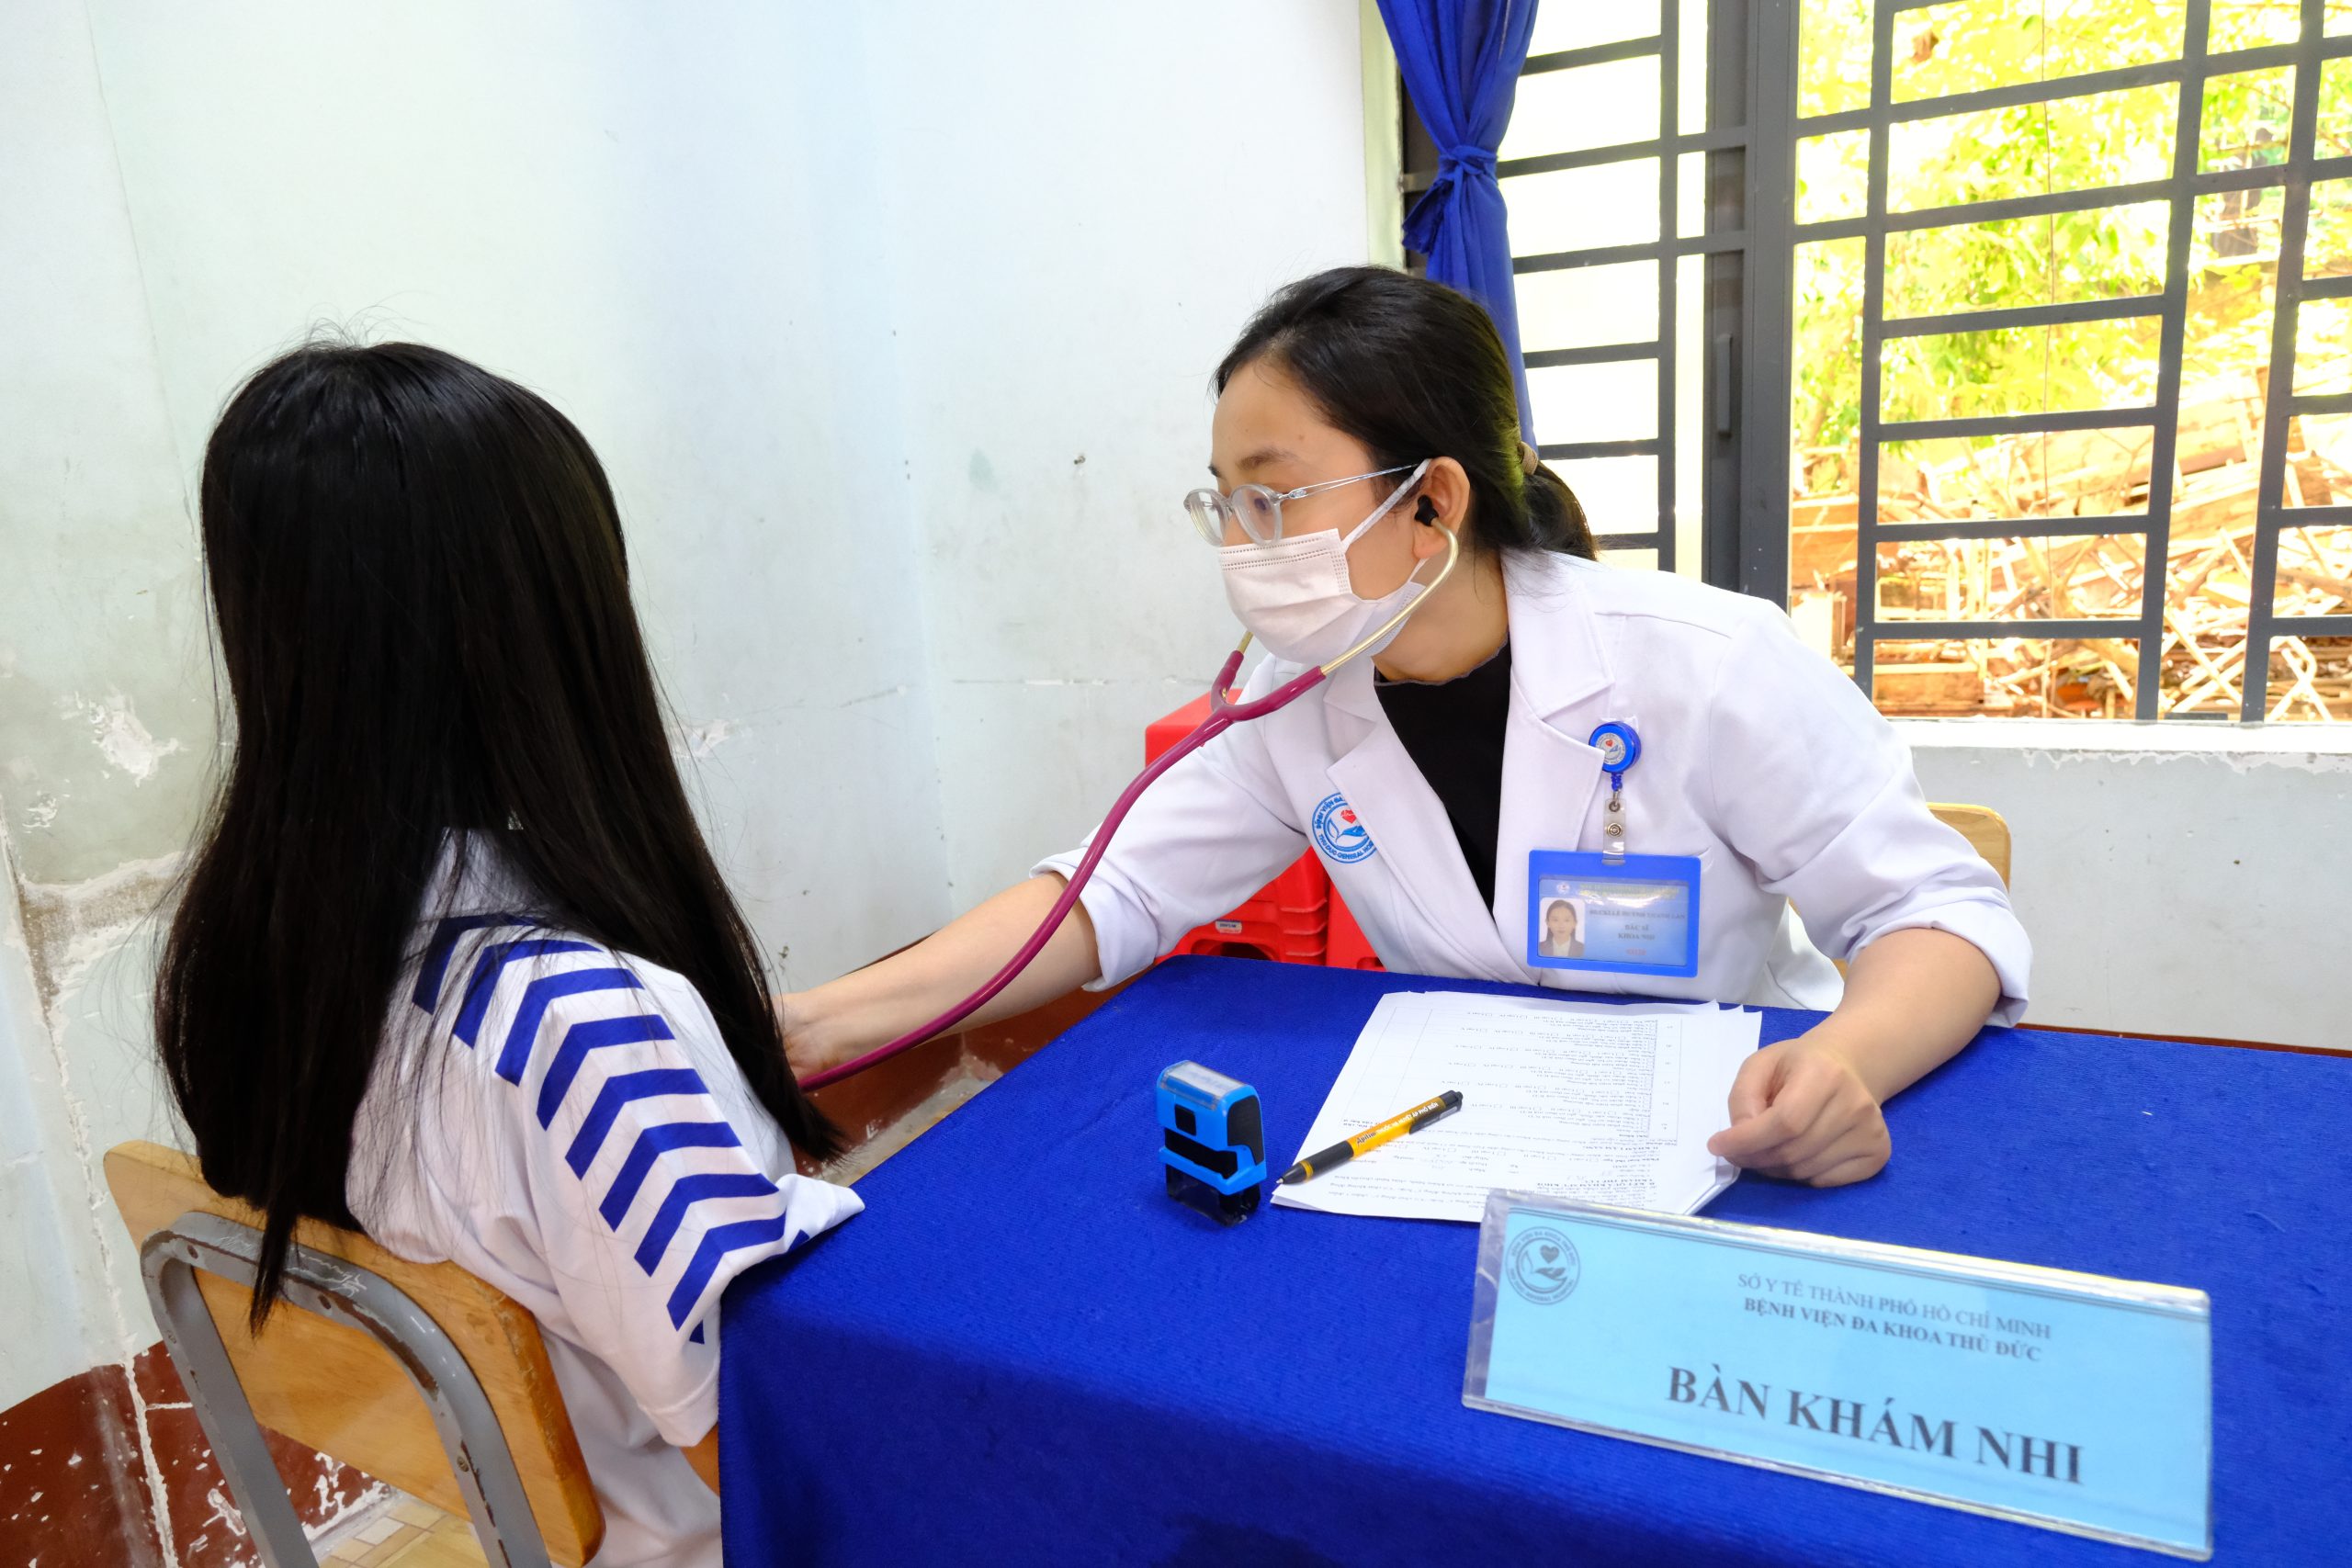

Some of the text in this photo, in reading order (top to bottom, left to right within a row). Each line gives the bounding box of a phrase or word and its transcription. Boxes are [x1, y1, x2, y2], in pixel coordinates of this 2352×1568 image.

[1737, 1272, 2052, 1339] SỞ Y TẾ THÀNH PHỐ HỒ CHÍ MINH
[1744, 1296, 2042, 1362] BỆNH VIỆN ĐA KHOA THỦ ĐỨC
[1667, 1363, 2085, 1485] BÀN KHÁM NHI
